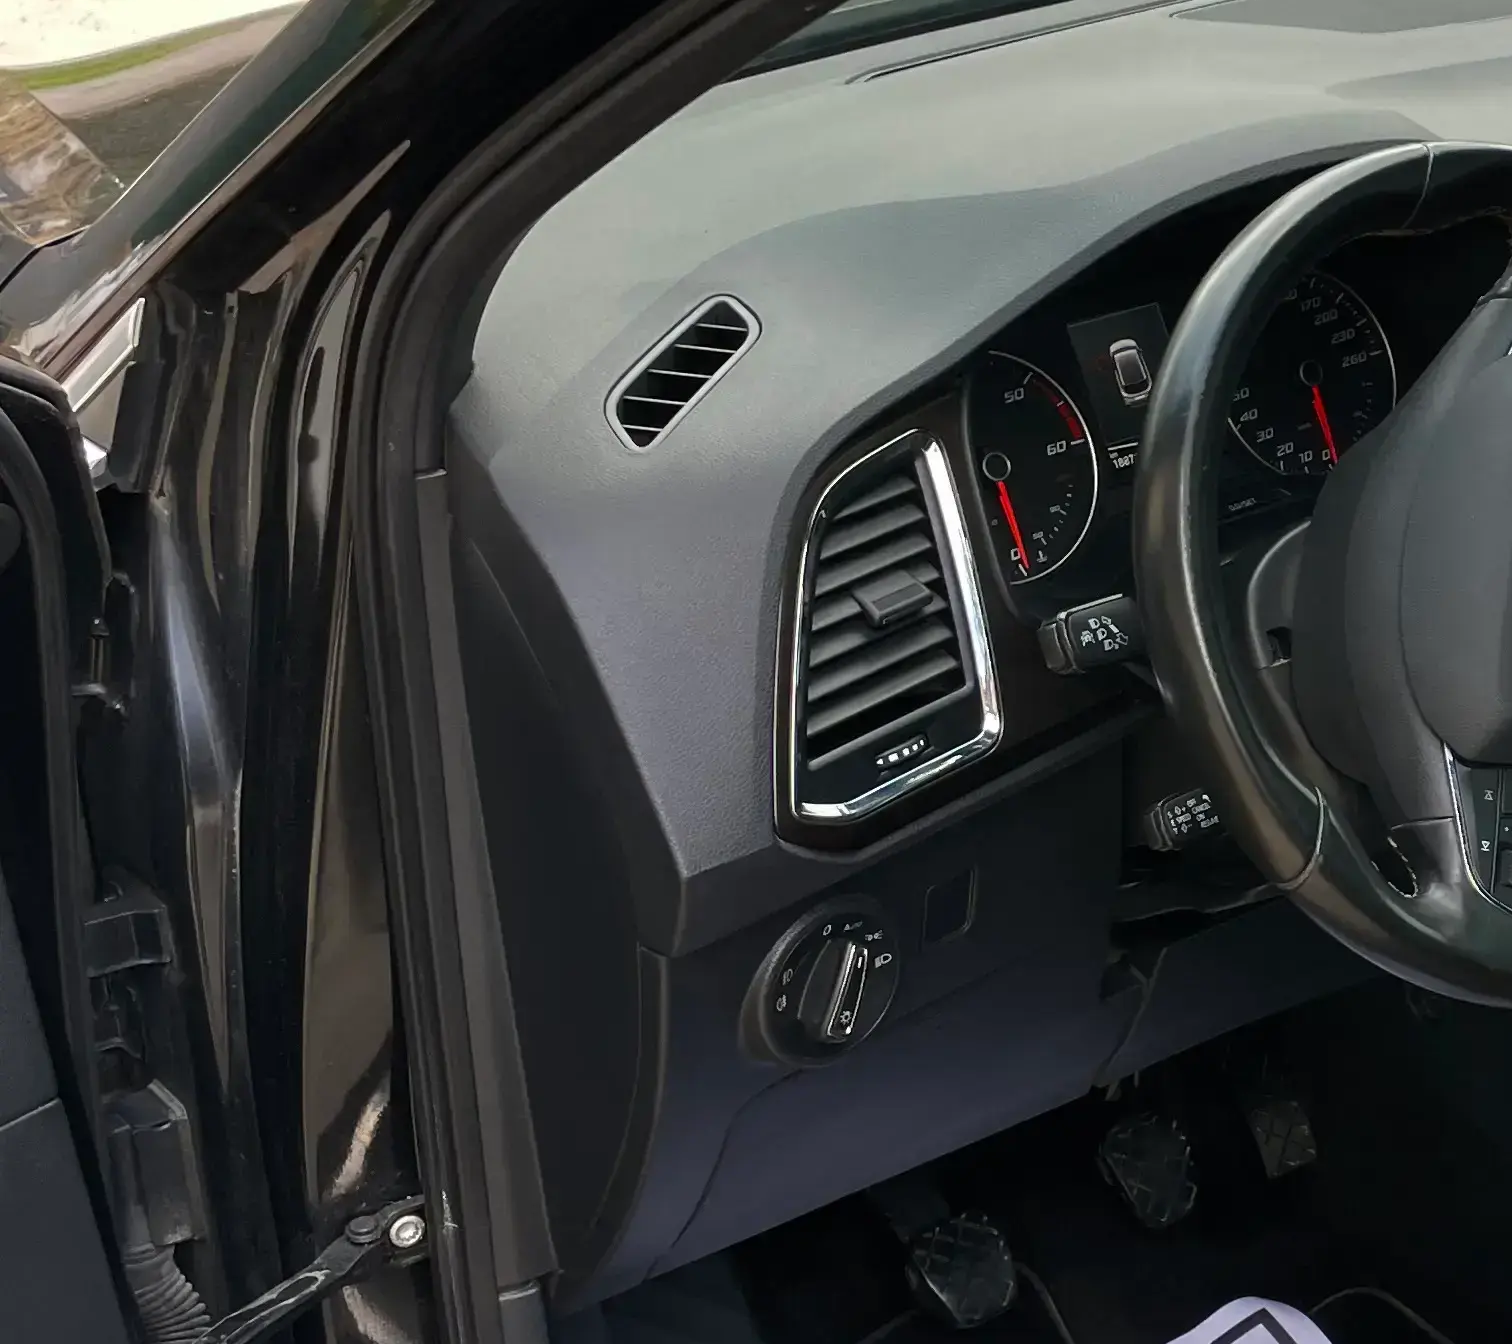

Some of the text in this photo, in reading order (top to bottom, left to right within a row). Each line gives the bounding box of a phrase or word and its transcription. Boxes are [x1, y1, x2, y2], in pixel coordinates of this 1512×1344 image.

[1314, 309, 1338, 326] 200
[1331, 327, 1355, 345] 230
[1342, 351, 1367, 367] 260
[1004, 387, 1025, 404] 50
[1239, 408, 1258, 423] 40
[1256, 427, 1274, 443] 30
[1046, 440, 1067, 456] 60
[1276, 441, 1294, 457] 20
[1299, 451, 1313, 464] 10
